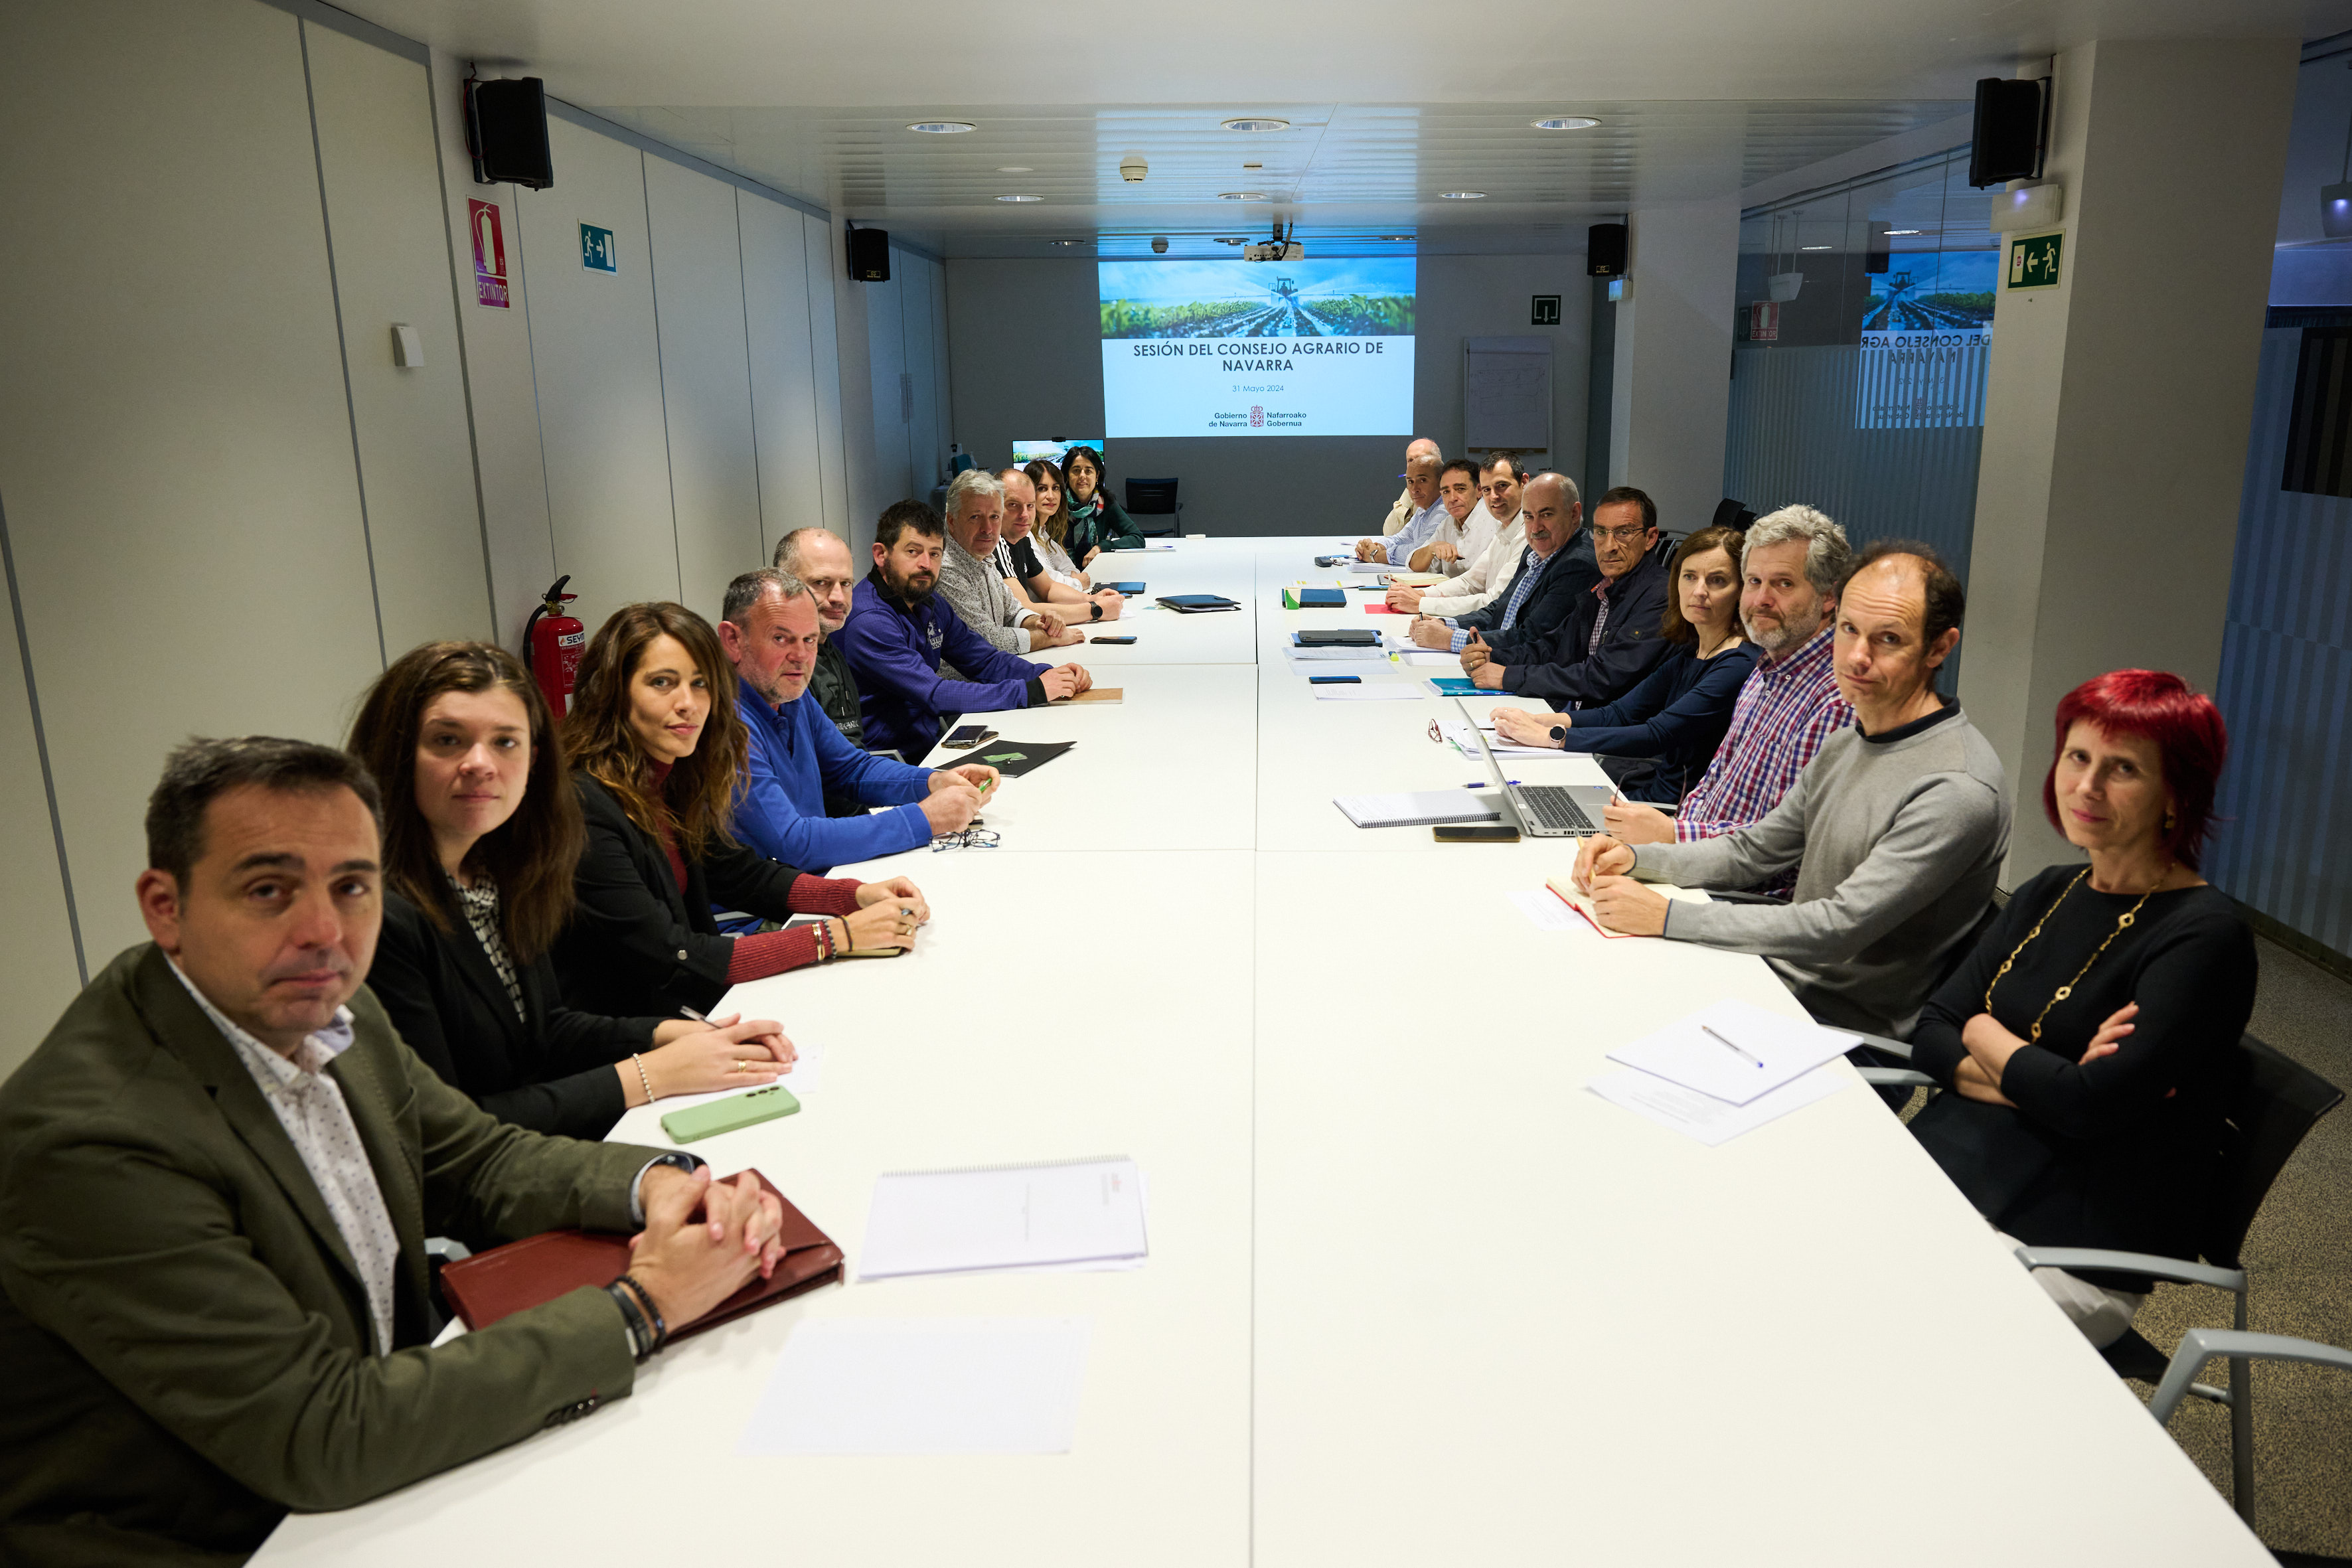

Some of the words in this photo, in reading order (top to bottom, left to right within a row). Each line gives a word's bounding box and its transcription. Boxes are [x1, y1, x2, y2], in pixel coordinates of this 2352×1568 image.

[478, 281, 509, 302] EXTINTOR
[1134, 341, 1184, 356] SESIÓN
[1189, 344, 1213, 356] DEL
[1217, 343, 1287, 355] CONSEJO
[1292, 342, 1360, 354] AGRARIO
[1366, 342, 1383, 354] DE
[1223, 359, 1294, 372] NAVARRA
